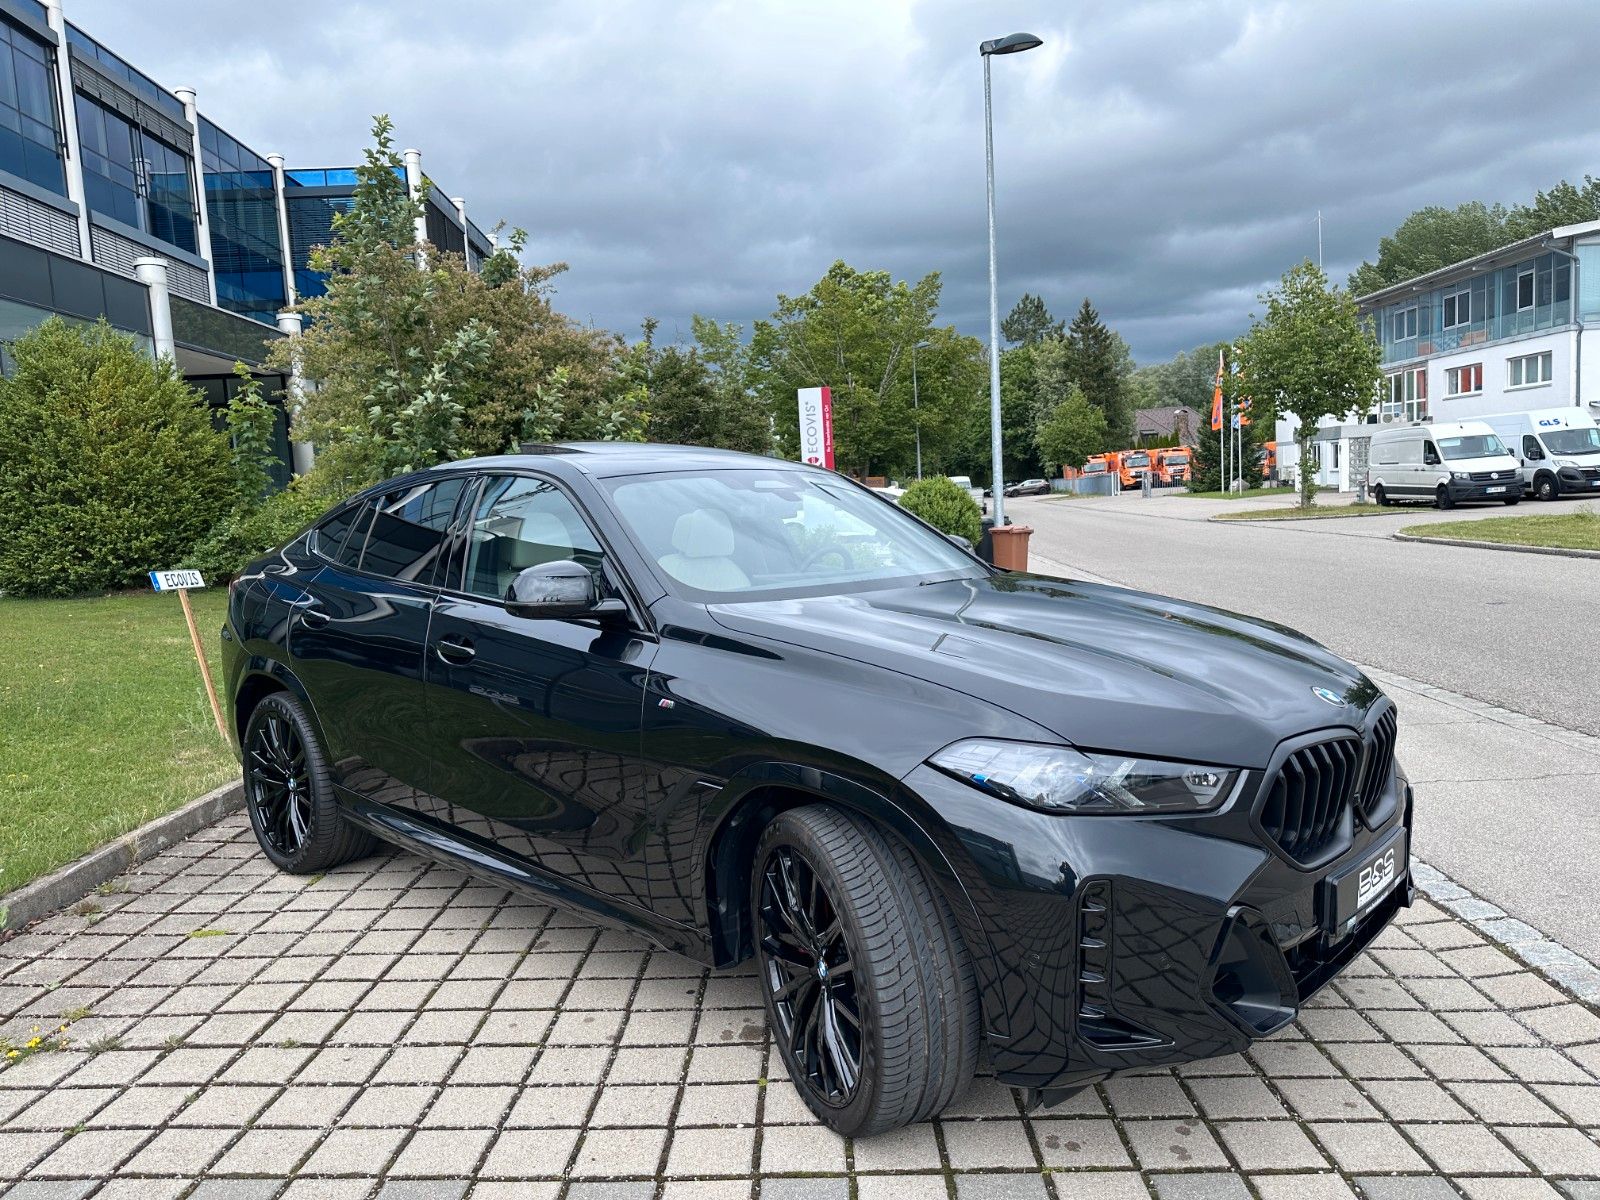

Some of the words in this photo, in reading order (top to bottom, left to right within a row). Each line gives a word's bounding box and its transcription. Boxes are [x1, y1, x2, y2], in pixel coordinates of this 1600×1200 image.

[805, 404, 818, 454] ECOVIS
[1539, 418, 1561, 427] GLS
[164, 572, 200, 588] ECOVIS
